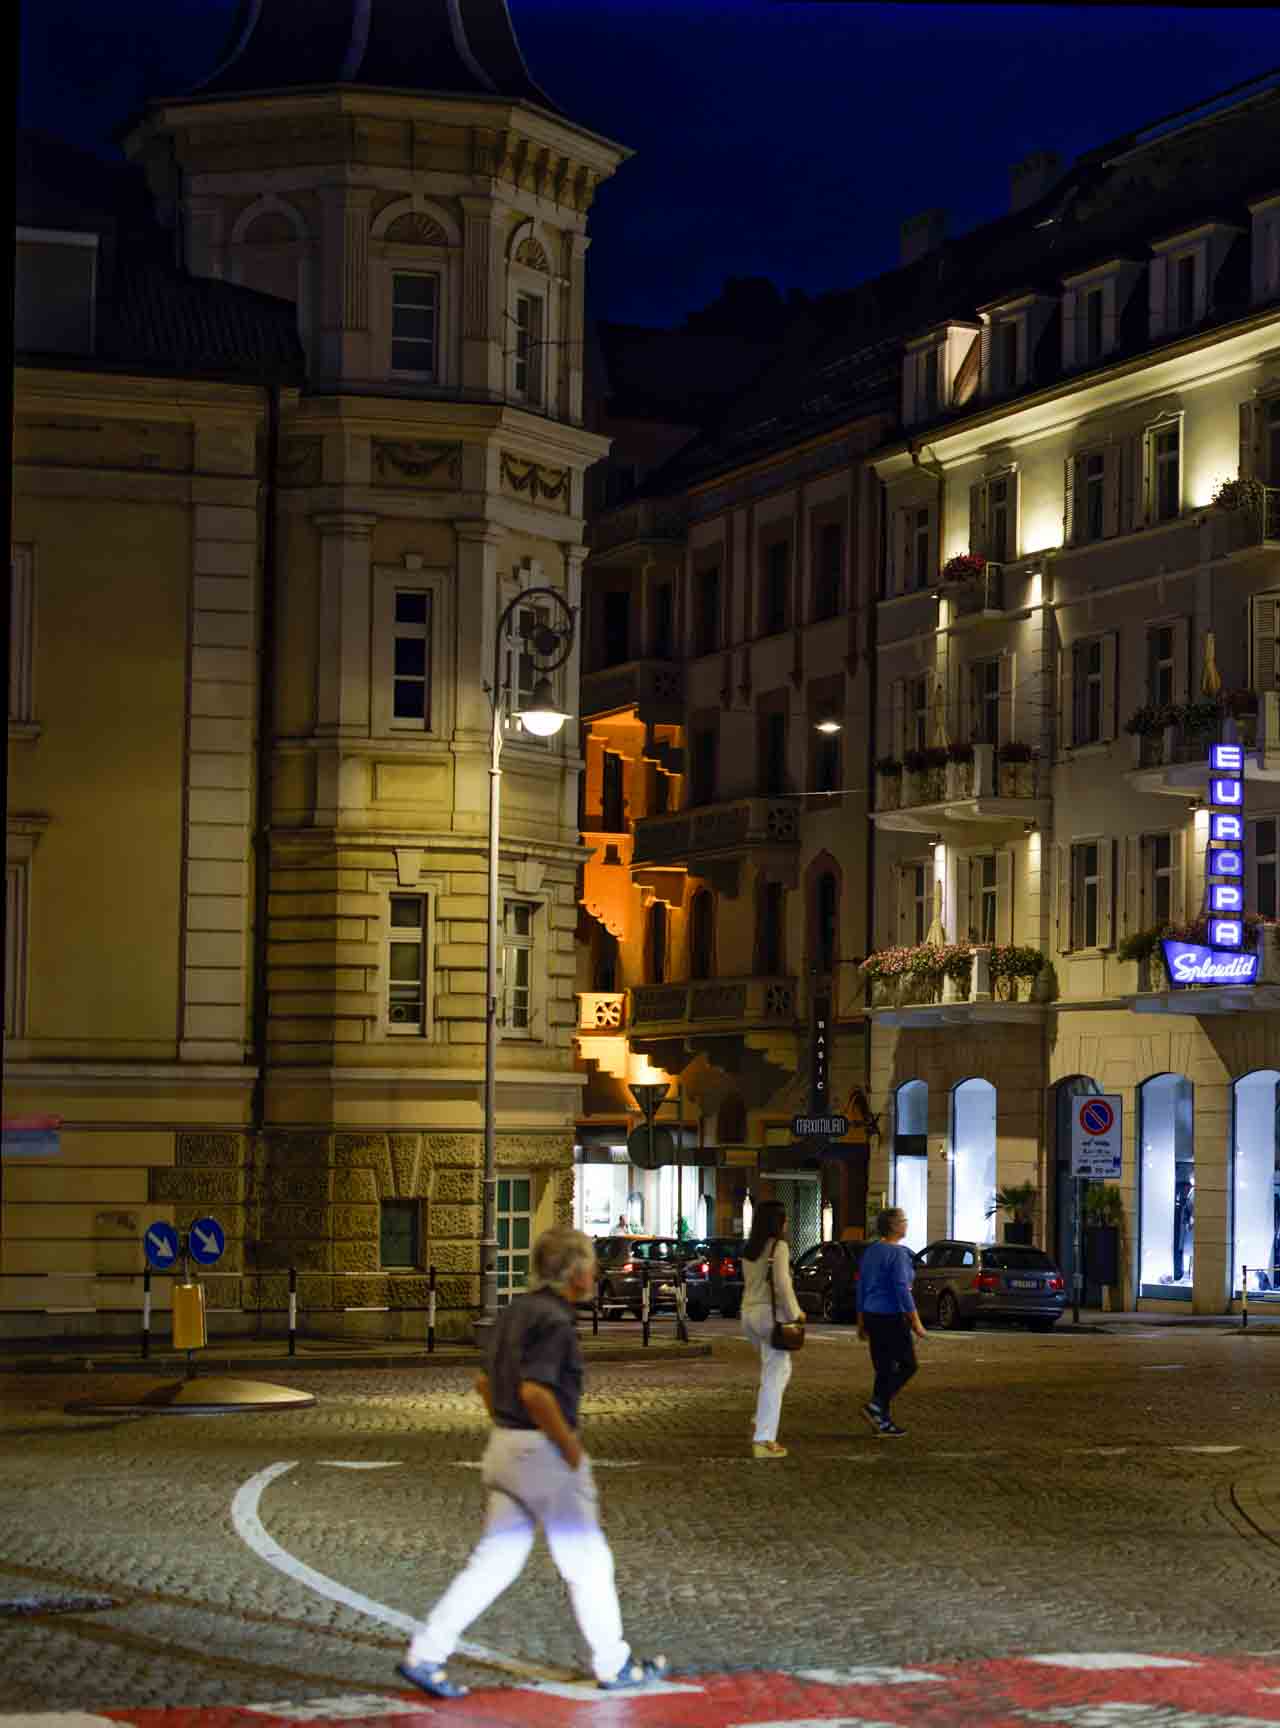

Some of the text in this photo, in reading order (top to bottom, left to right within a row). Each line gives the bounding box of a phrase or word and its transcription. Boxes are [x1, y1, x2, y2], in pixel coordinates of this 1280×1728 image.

[1215, 746, 1241, 945] EUROPA
[1173, 952, 1256, 982] Splendid
[816, 1020, 825, 1089] BASIC
[796, 1119, 846, 1135] MAXIMILIAN
